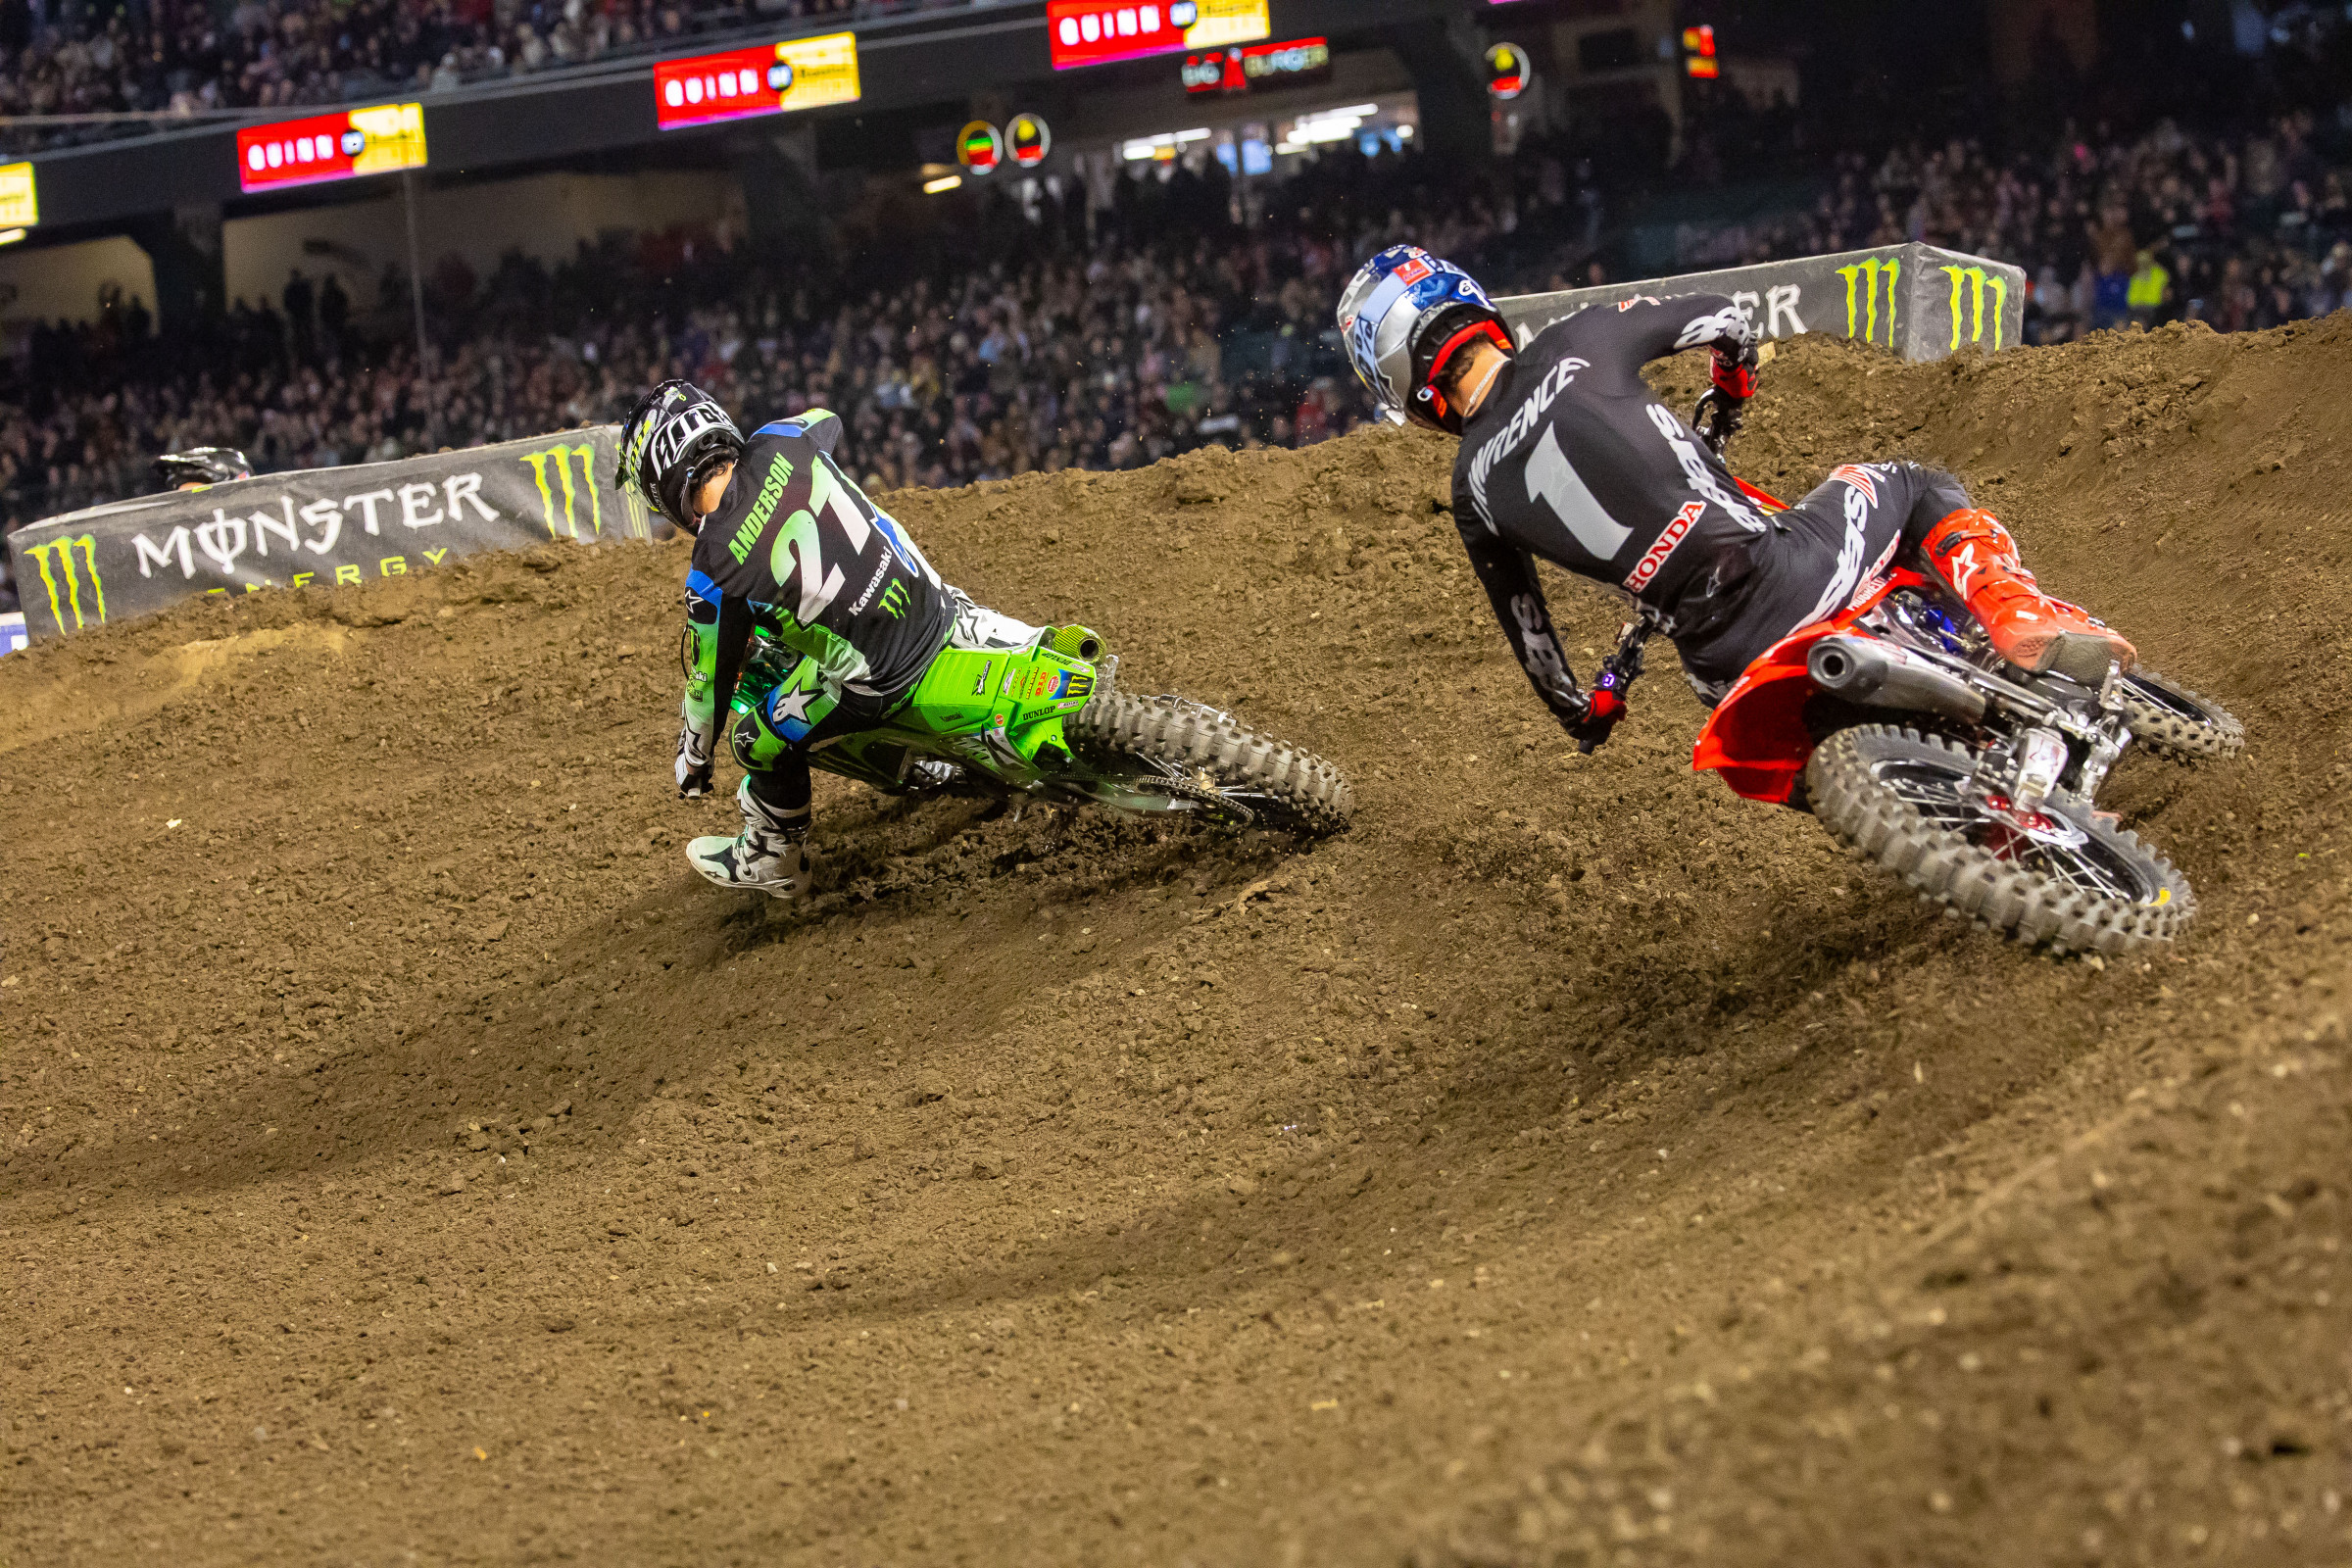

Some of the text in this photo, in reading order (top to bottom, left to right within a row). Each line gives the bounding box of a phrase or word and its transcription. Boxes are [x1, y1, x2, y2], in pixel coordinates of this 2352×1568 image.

[131, 472, 501, 579] MONSTER
[727, 451, 795, 565] ANDERSON
[770, 454, 871, 627] 21
[1524, 420, 1636, 562] 1
[207, 547, 448, 594] ERGY
[848, 545, 893, 616] Kawasaki
[1623, 501, 1707, 593] HONDA
[1022, 705, 1056, 721] DUNLOP
